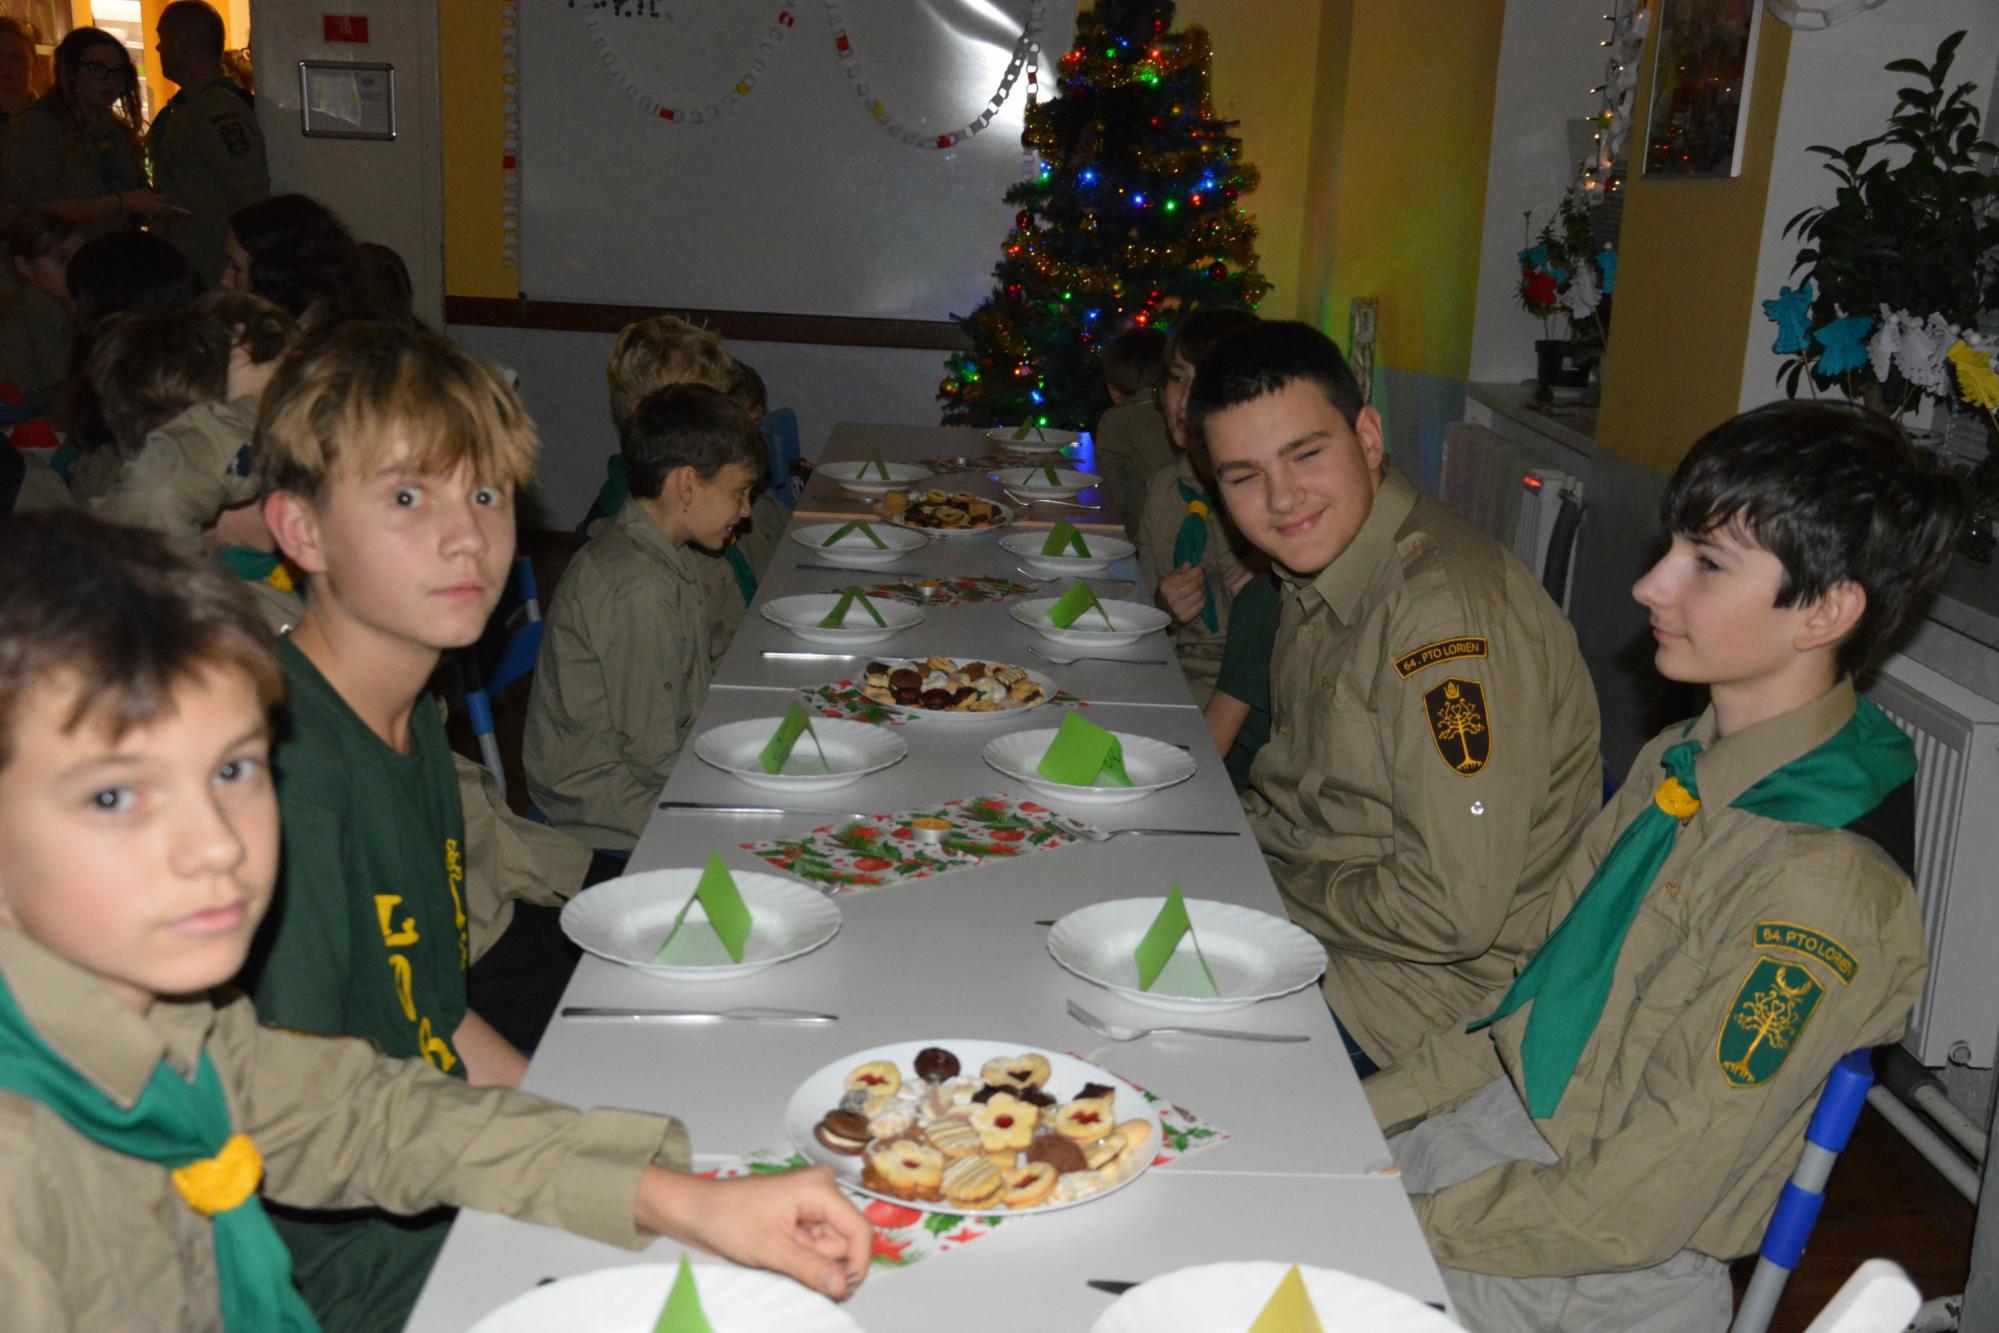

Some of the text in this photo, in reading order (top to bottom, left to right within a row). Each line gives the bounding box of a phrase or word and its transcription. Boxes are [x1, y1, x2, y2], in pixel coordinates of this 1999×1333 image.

[1421, 648, 1442, 662] PTO
[1443, 642, 1479, 656] LORIEN
[1786, 931, 1818, 951] PTO
